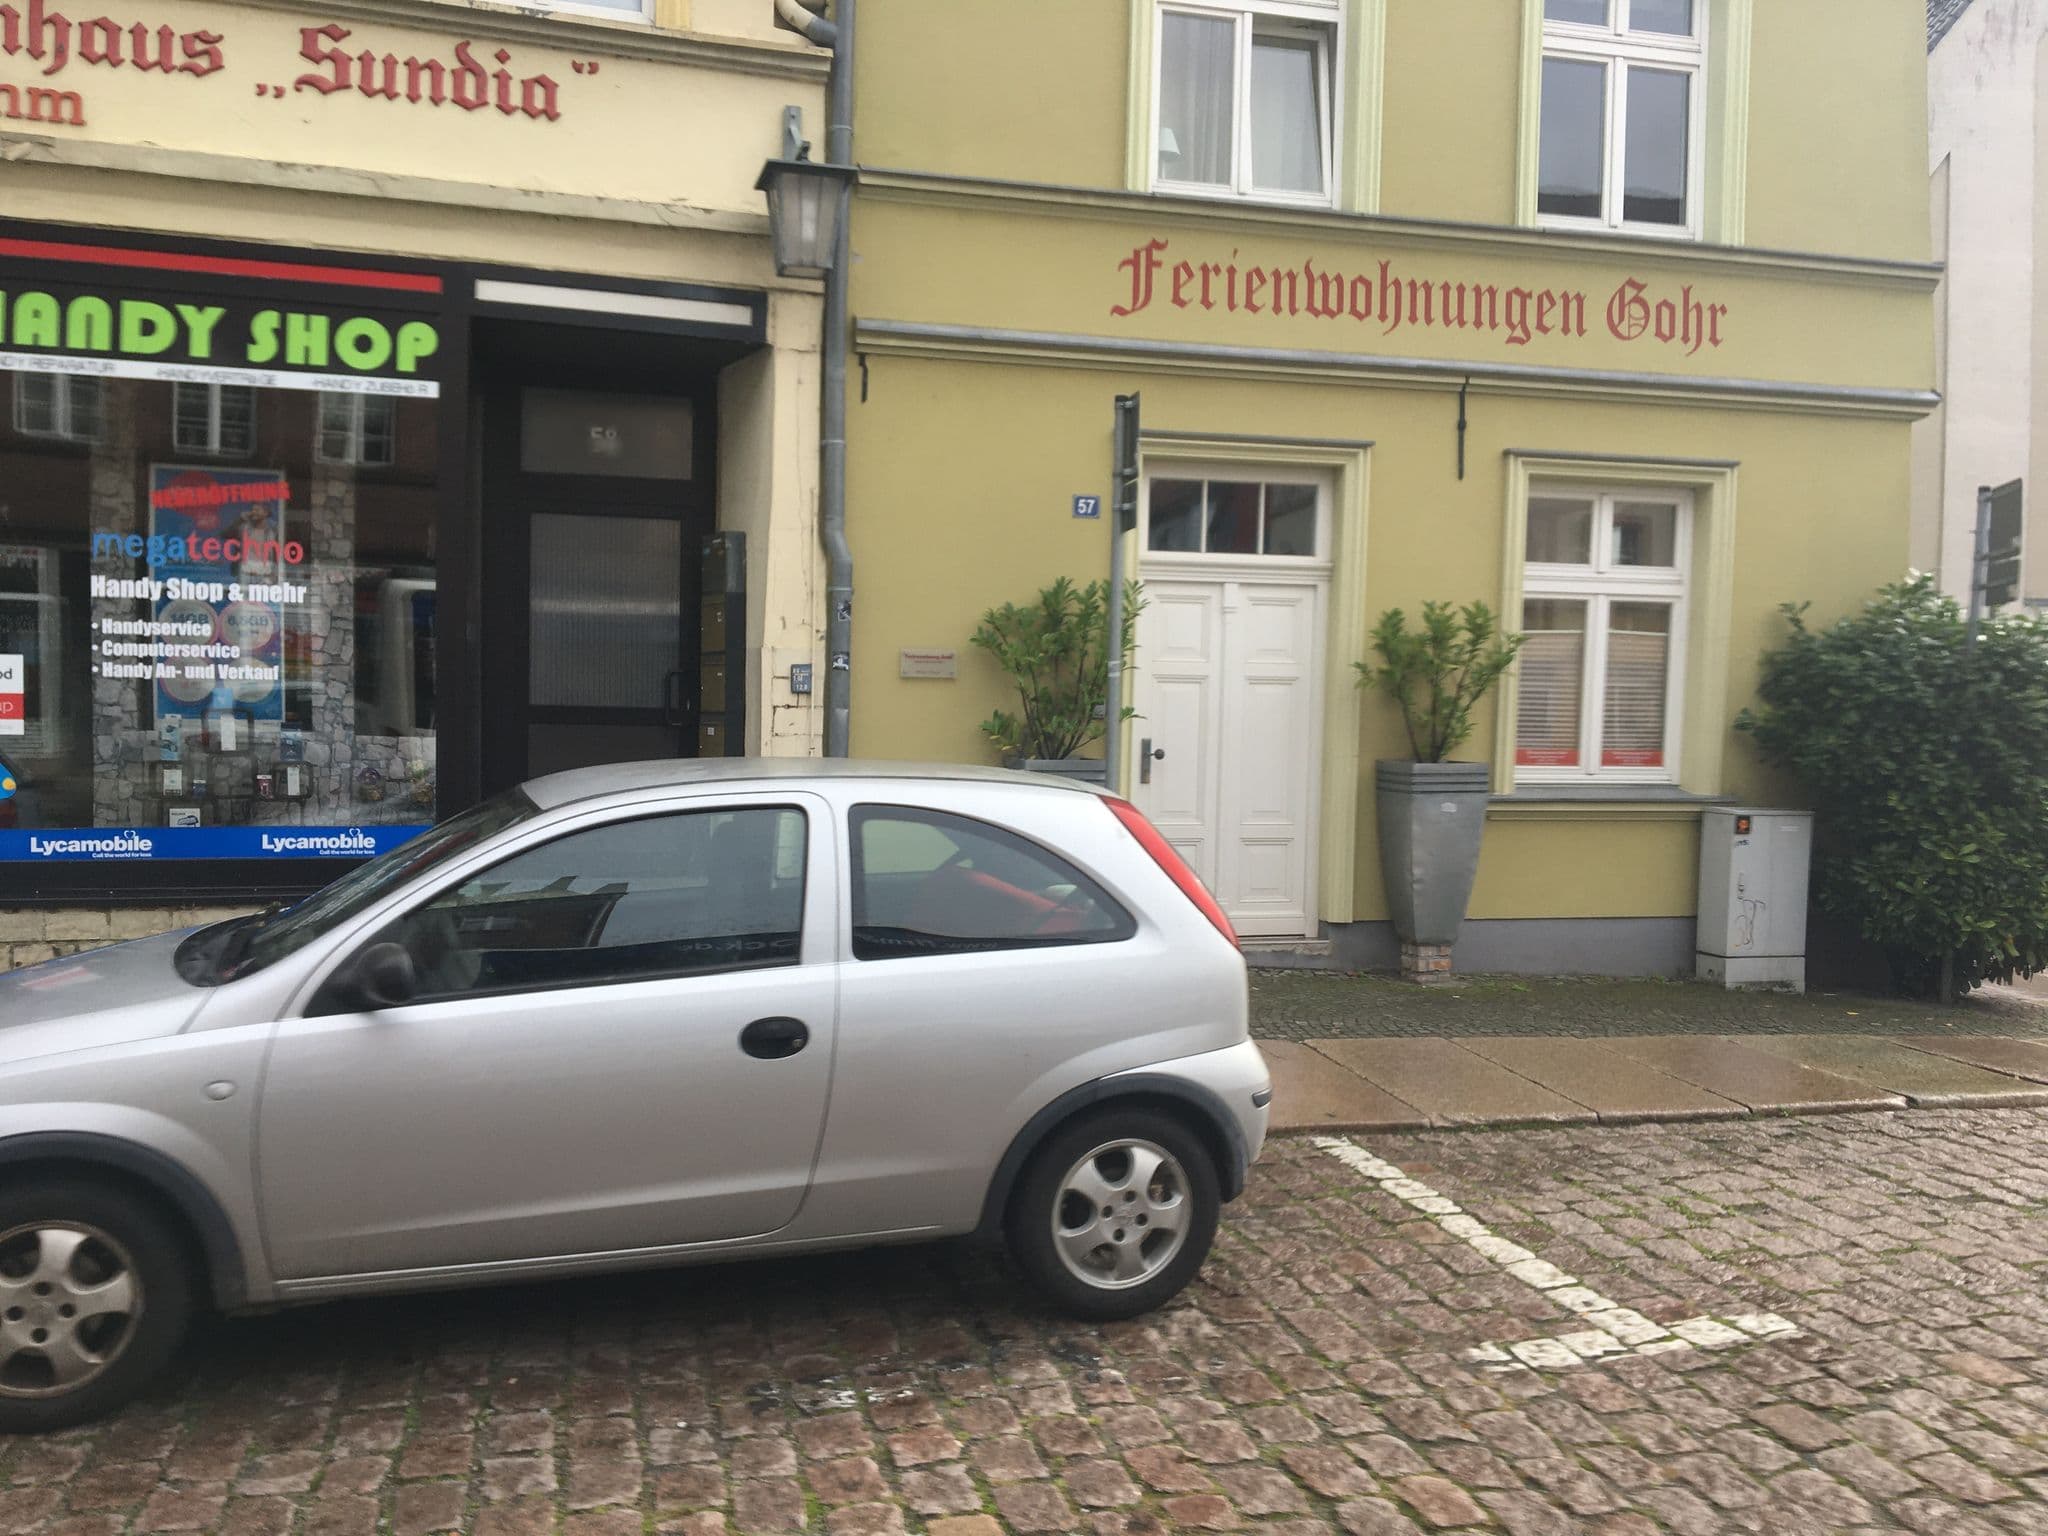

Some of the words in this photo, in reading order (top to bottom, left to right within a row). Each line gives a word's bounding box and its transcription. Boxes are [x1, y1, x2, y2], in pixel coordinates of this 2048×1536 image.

[1110, 238, 1588, 345] Ferienwohnungen
[1606, 276, 1729, 357] Gohr
[0, 290, 225, 358] ANDY
[247, 310, 439, 372] SHOP
[1078, 498, 1096, 514] 57
[92, 528, 304, 567] megatechno
[90, 575, 162, 600] Handy
[166, 578, 223, 602] Shop
[228, 583, 244, 601] &
[249, 582, 307, 603] mehr
[102, 618, 211, 637] Handyservice
[102, 640, 240, 658] Computerservice
[102, 662, 152, 679] Handy
[155, 663, 182, 679] An-
[185, 664, 215, 679] und
[218, 664, 279, 680] Verkauf
[30, 834, 152, 856] Lycamobile
[262, 832, 375, 852] Lycamobile
